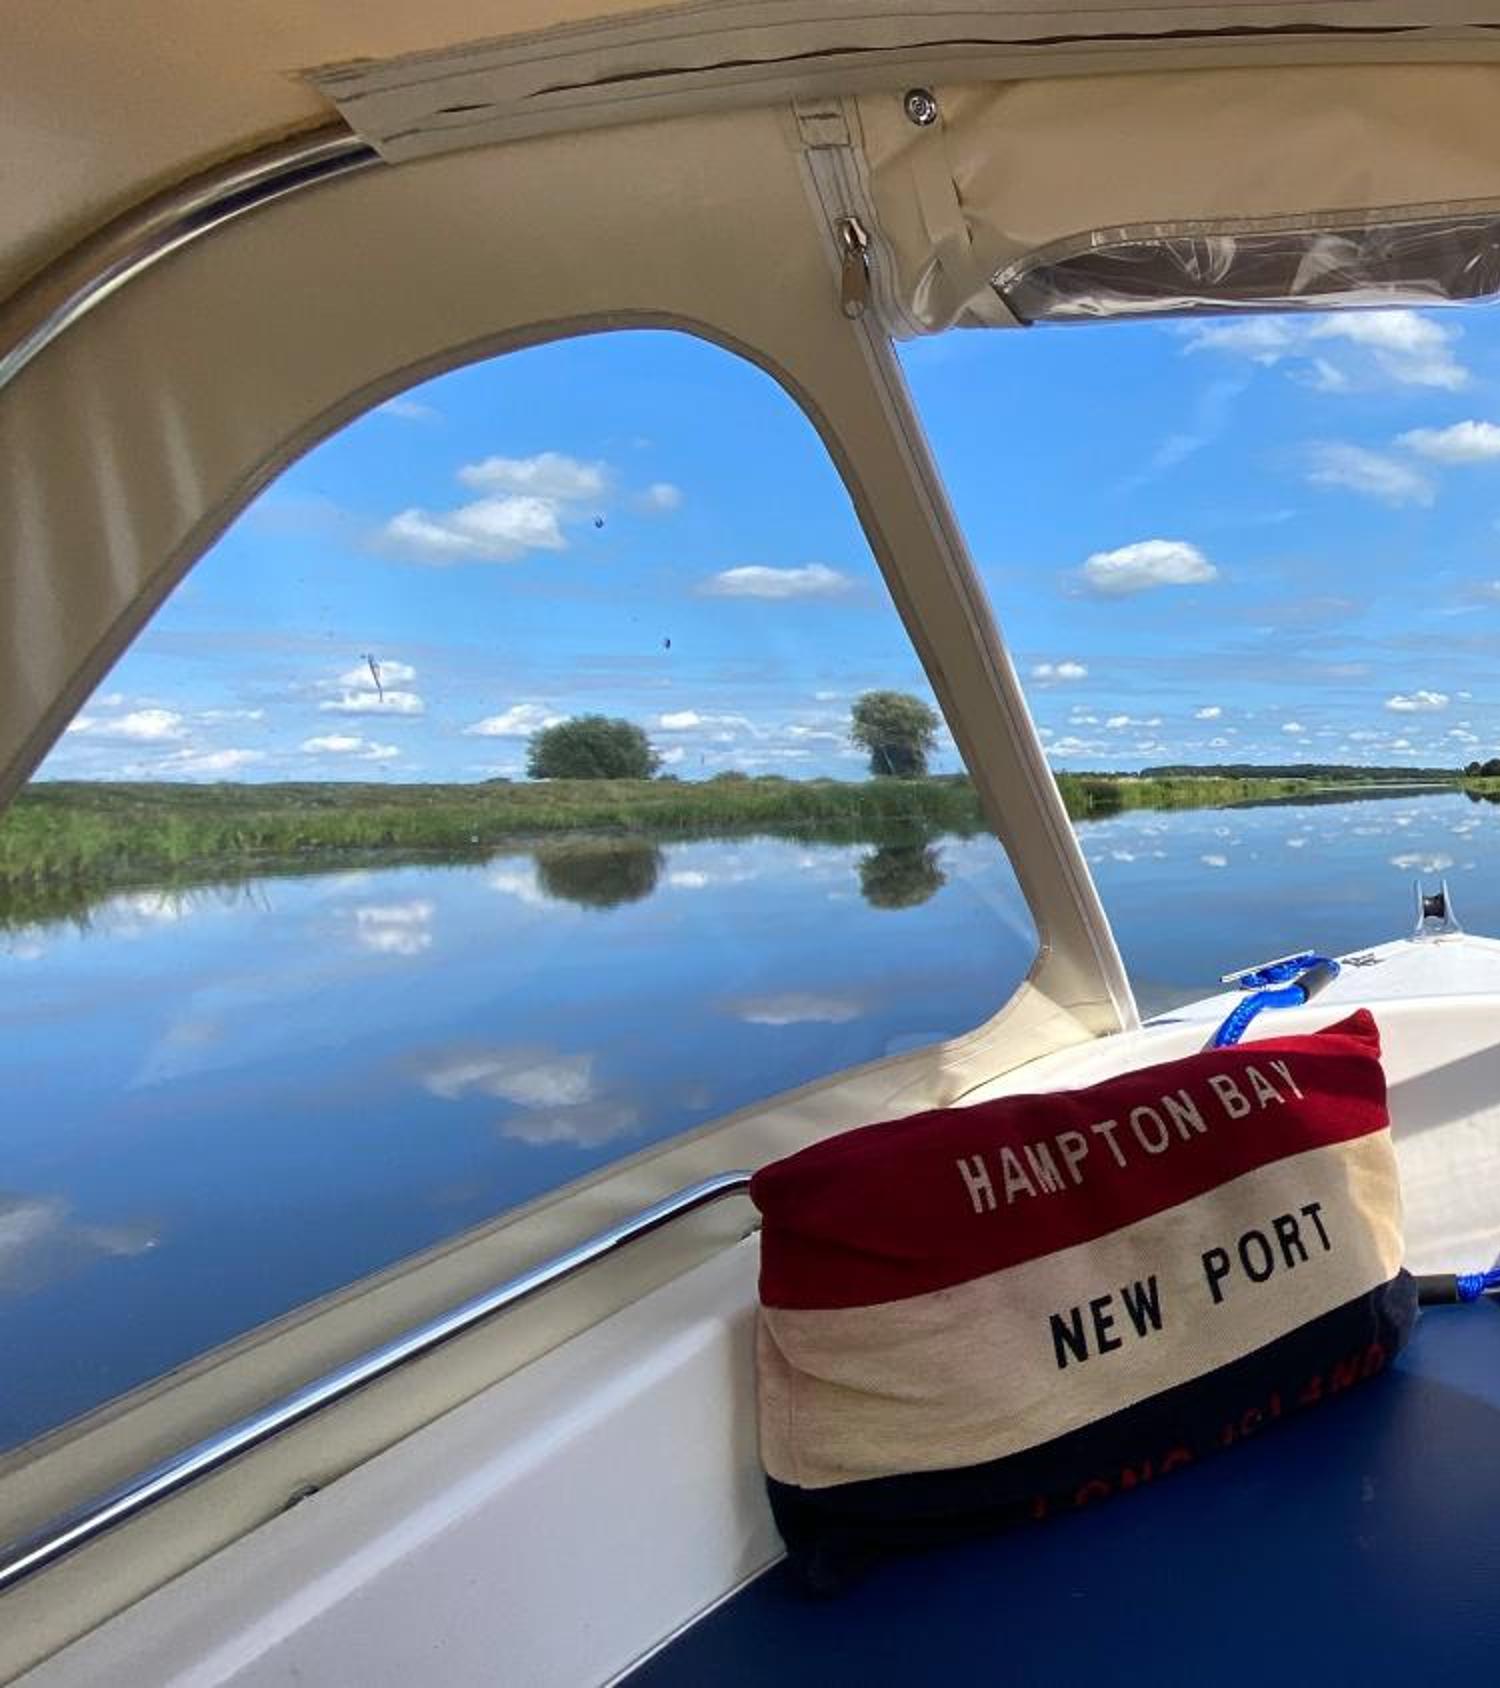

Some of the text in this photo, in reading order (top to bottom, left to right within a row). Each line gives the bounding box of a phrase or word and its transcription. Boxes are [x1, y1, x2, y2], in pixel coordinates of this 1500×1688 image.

[956, 1059, 1304, 1214] HAMPTON BAY
[1049, 1202, 1333, 1369] NEW PORT
